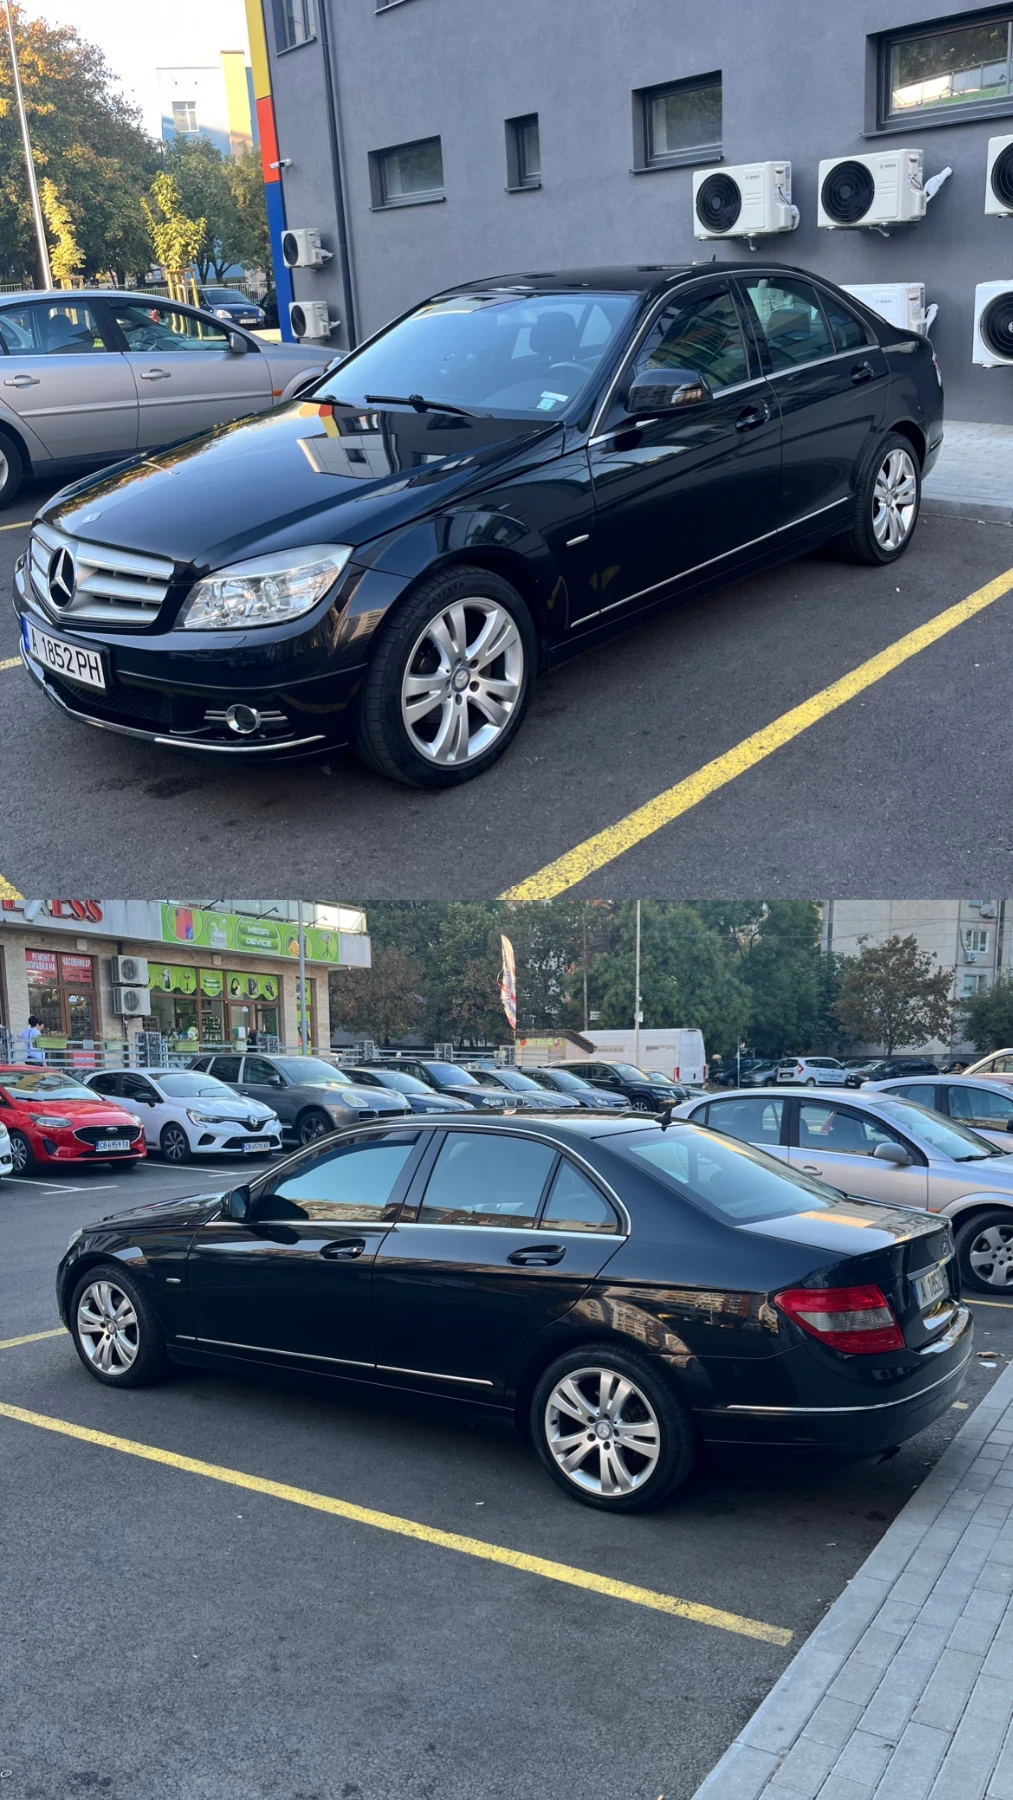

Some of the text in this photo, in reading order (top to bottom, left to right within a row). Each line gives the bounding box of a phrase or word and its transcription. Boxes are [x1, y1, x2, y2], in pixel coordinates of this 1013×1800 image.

[31, 628, 102, 683] A 1852PH
[247, 926, 270, 937] MEGA
[245, 937, 272, 948] DEVICE
